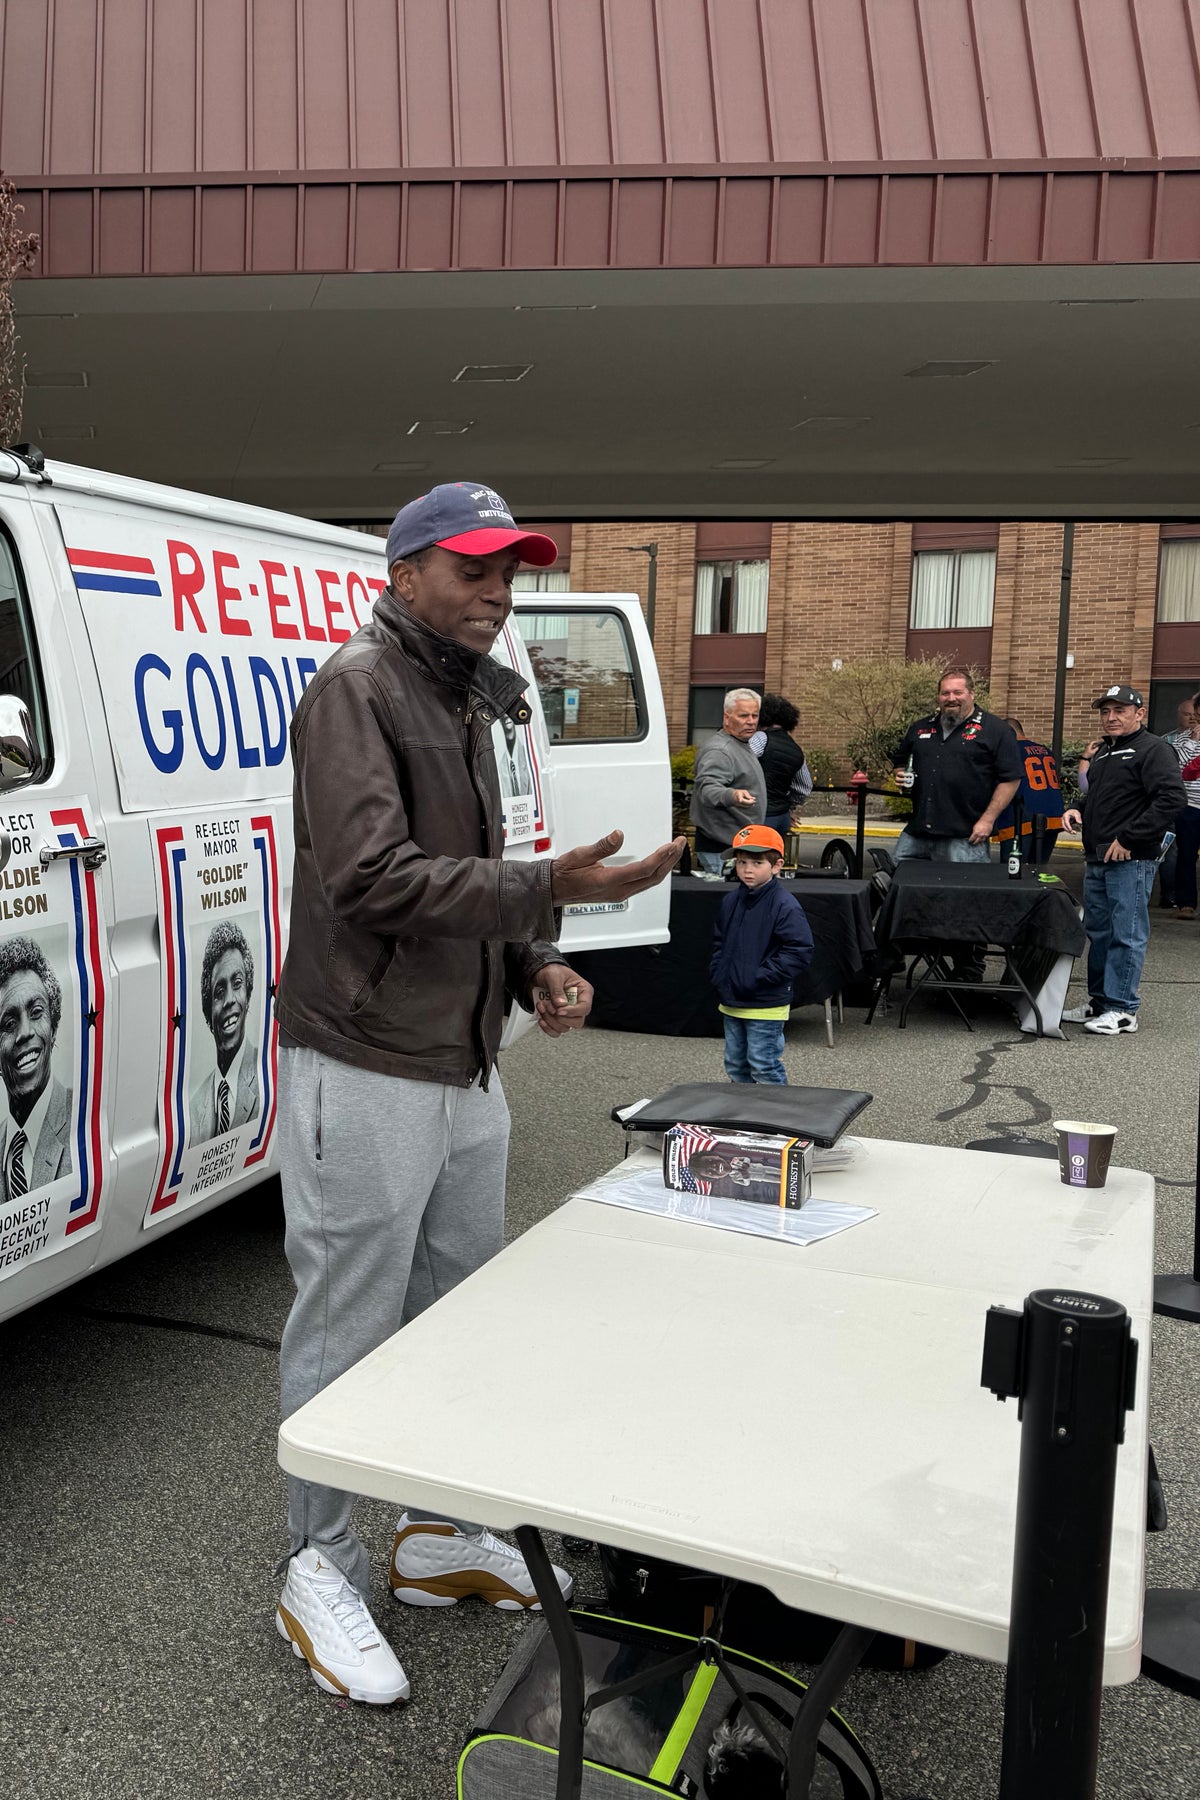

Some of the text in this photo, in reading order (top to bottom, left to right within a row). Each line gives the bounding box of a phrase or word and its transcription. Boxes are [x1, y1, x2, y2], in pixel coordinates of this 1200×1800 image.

[1025, 756, 1060, 791] 66
[195, 820, 240, 838] RE-ELECT
[204, 839, 238, 857] MAYOR
[197, 862, 249, 885] “GOLDIE”
[201, 886, 247, 910] WILSON
[607, 903, 624, 911] FORD
[201, 1136, 240, 1163] HONESTY
[197, 1152, 236, 1179] DECENCY
[190, 1165, 234, 1195] INTEGRITY
[790, 1160, 799, 1200] HONESTY
[1052, 1297, 1100, 1310] ULINE
